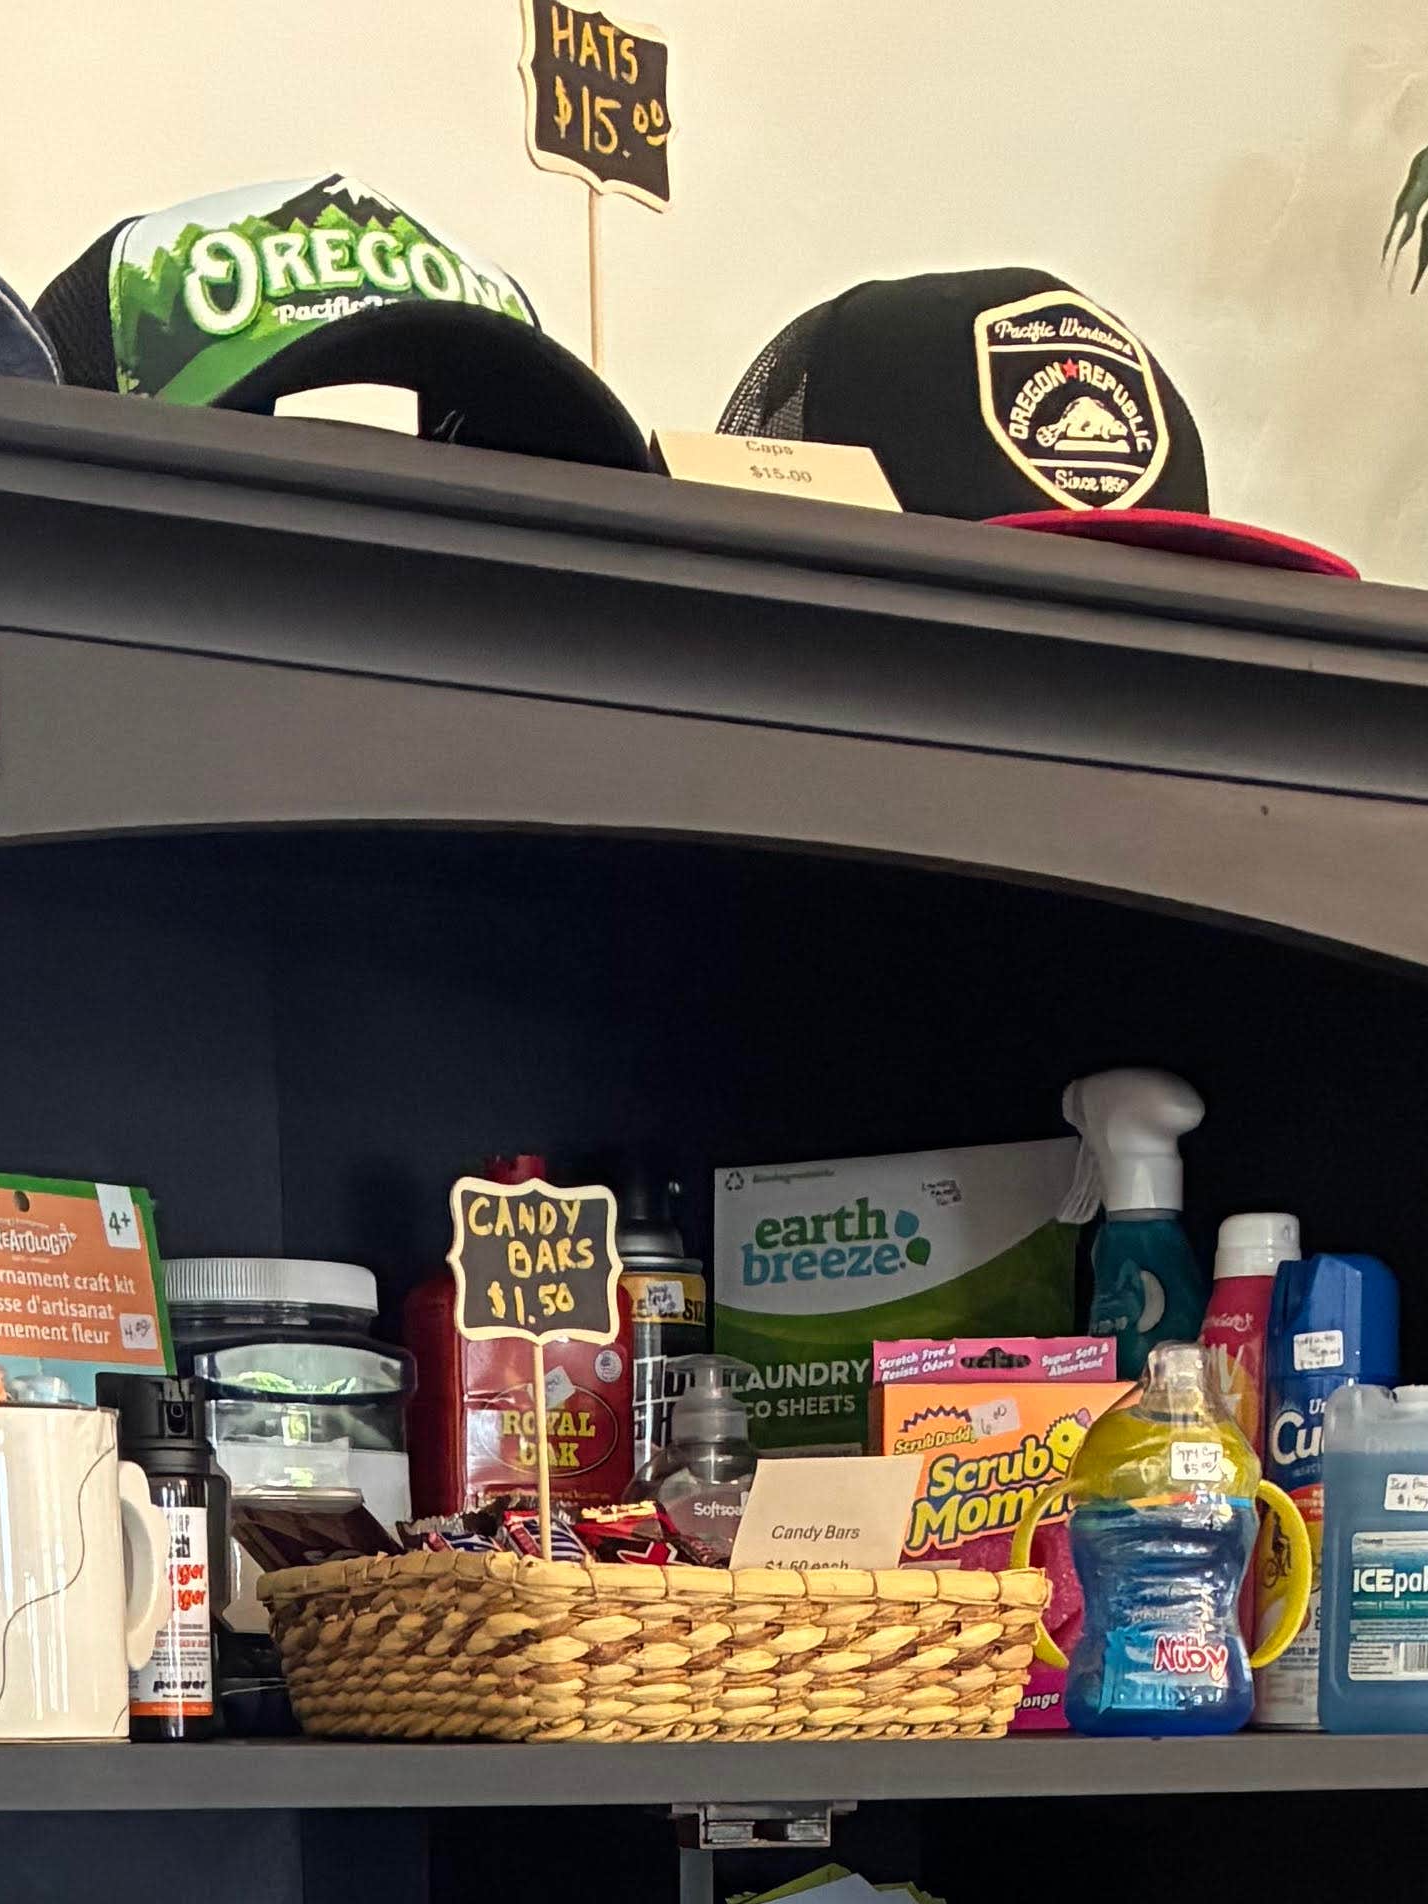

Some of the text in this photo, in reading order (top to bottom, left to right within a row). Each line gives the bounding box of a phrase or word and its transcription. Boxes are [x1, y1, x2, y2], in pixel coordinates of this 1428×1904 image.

[551, 5, 639, 84] HATS
[994, 320, 1057, 342] Pacific
[1009, 359, 1153, 453] OREGON REPUBLIC
[750, 465, 813, 485] $15.00
[1054, 469, 1099, 491] Since
[108, 1210, 132, 1235] 4+
[467, 1196, 582, 1238] CANDY
[755, 1197, 889, 1250] earth
[507, 1237, 596, 1279] BARS
[740, 1242, 901, 1287] breeze
[73, 1273, 112, 1292] craft
[114, 1275, 137, 1296] kit
[26, 1295, 116, 1320] d'artisanat
[486, 1279, 575, 1326] $1.50
[71, 1320, 111, 1345] fleur
[878, 1352, 919, 1371] Scratch
[1041, 1352, 1071, 1368] Super
[1074, 1346, 1098, 1361] Soft
[732, 1359, 870, 1393] LAUNDRY
[881, 1359, 954, 1382] Resists Odors
[775, 1394, 857, 1417] SHEETS
[928, 1434, 1051, 1499] Scrub
[693, 1502, 743, 1519] Softsoa
[771, 1525, 861, 1543] Candy Bars
